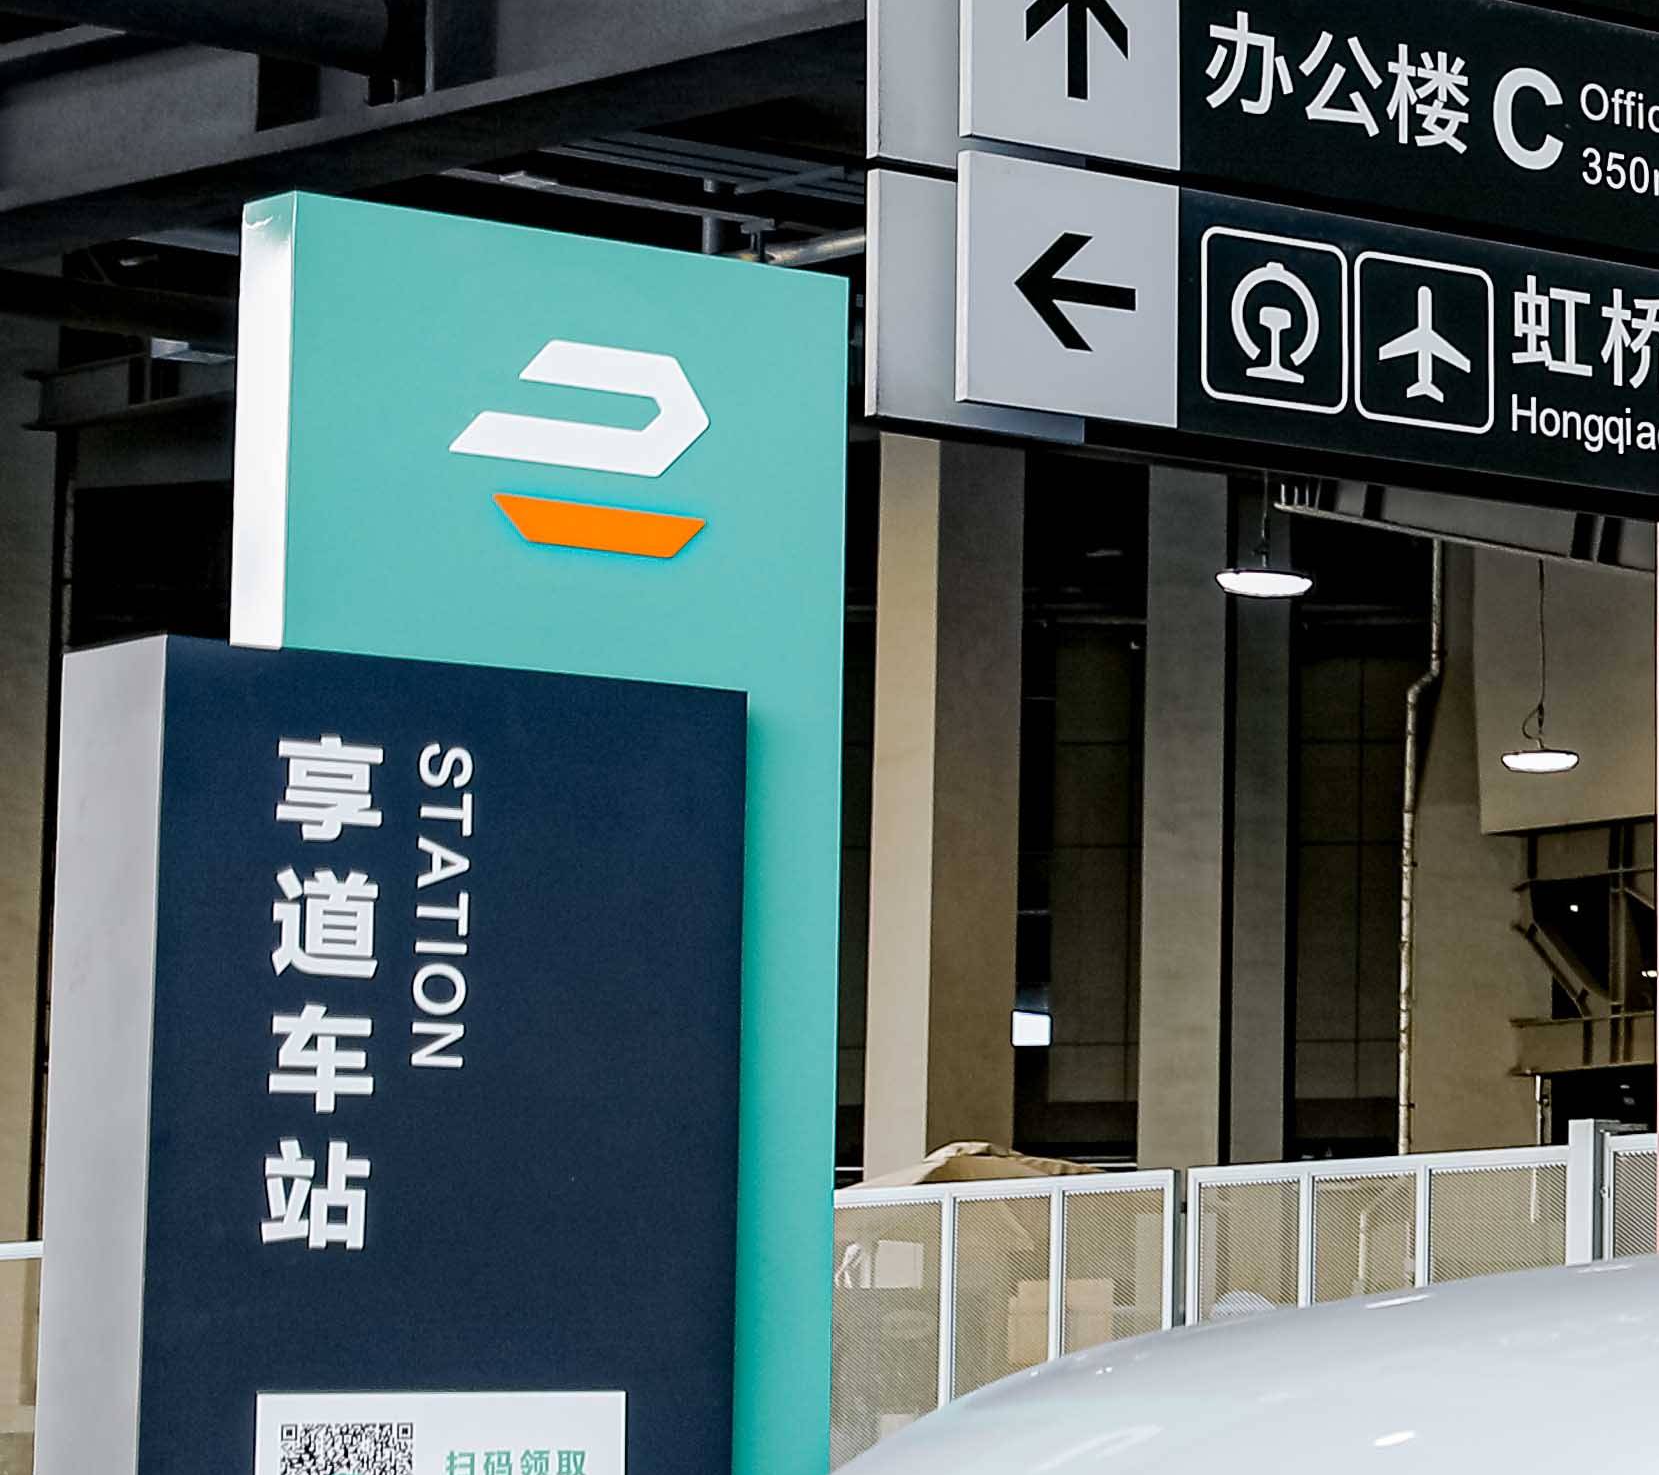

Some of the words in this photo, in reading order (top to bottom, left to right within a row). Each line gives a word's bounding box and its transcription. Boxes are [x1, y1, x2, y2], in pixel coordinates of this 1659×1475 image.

[1205, 10, 1470, 155] 办公楼
[1492, 67, 1564, 171] C
[261, 736, 384, 1250] 享道车站
[411, 743, 473, 1068] STATION
